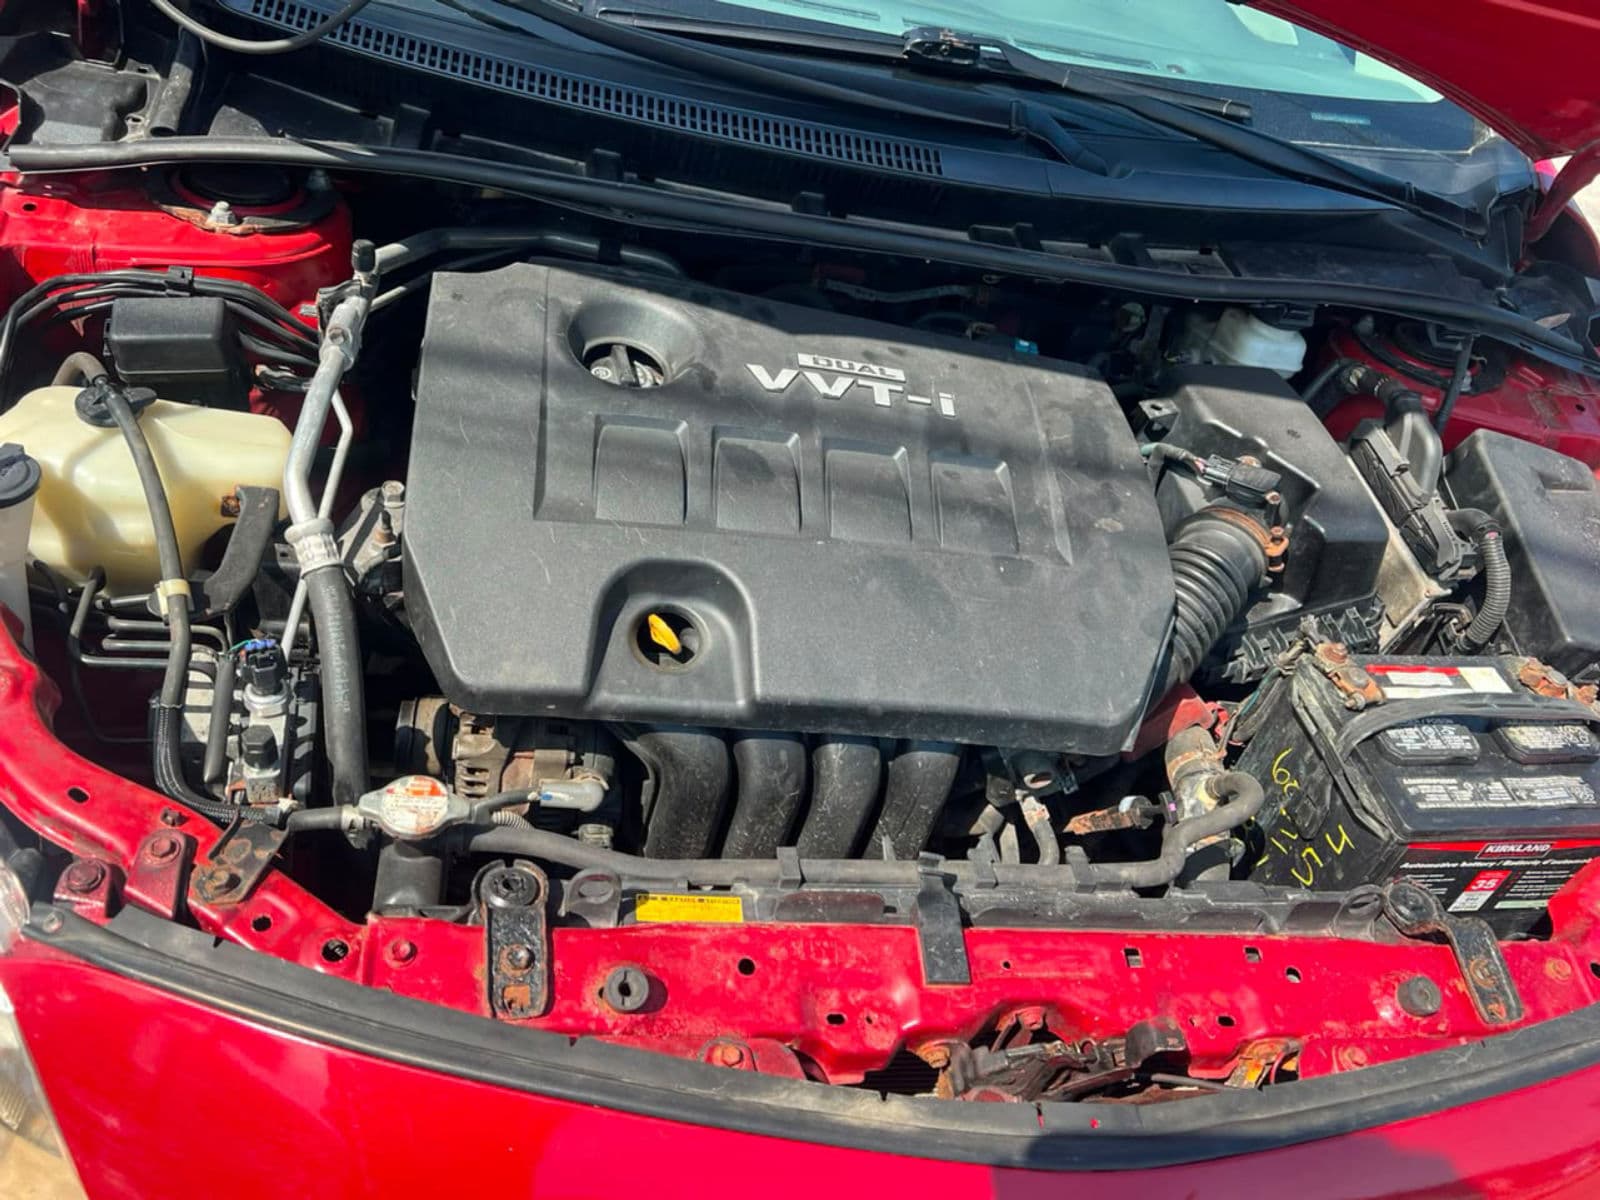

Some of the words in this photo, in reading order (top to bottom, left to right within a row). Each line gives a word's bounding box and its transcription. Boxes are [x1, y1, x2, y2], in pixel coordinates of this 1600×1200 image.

[812, 355, 898, 379] DUAL
[745, 363, 956, 417] VVT-i
[1483, 843, 1551, 854] KIRKLAND
[1471, 878, 1500, 890] 35
